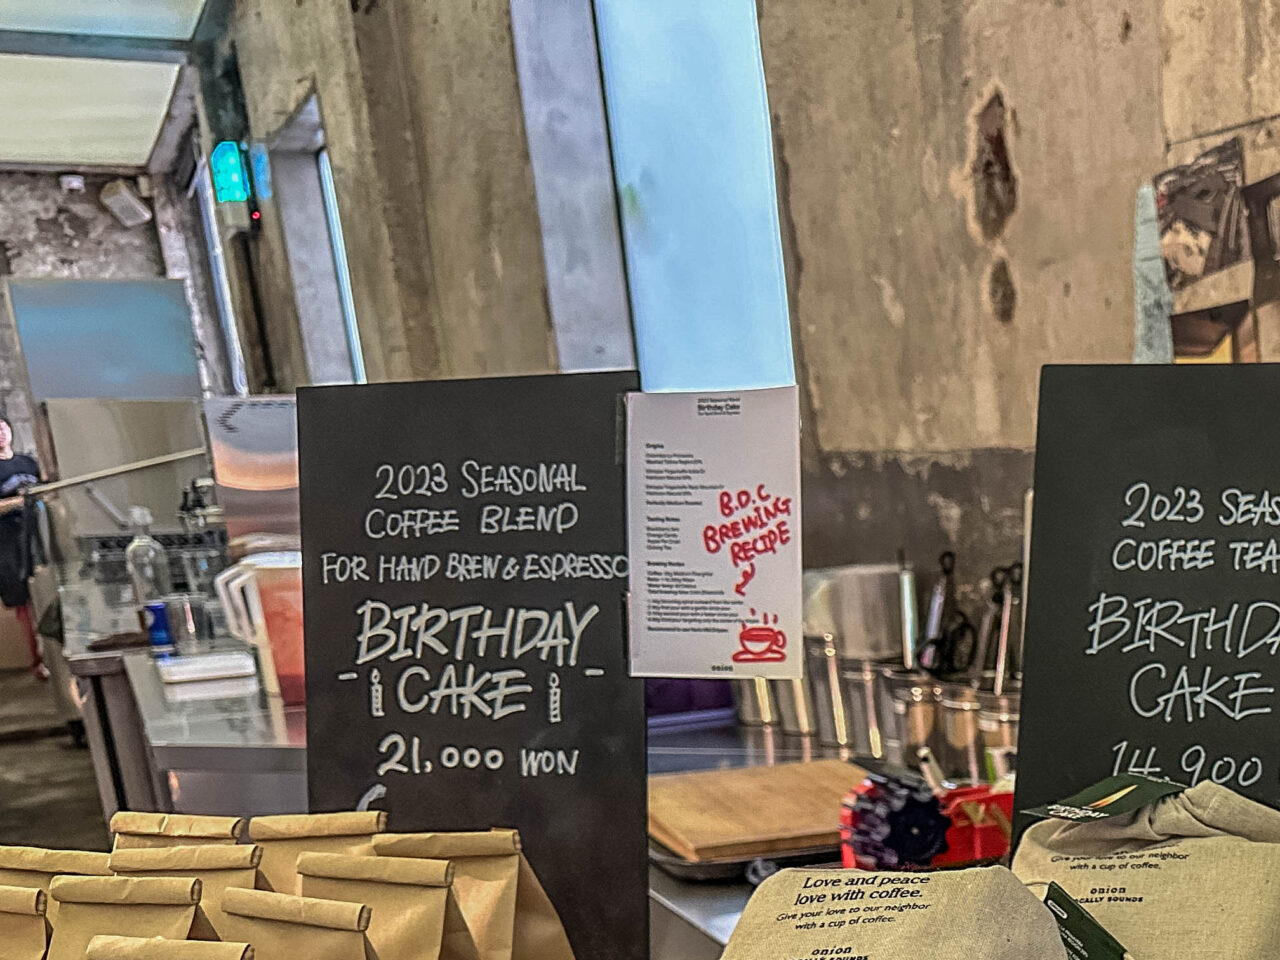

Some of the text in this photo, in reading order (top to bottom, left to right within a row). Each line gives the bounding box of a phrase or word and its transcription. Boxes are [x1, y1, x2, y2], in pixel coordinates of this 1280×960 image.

[376, 461, 587, 499] 2023 SEASONAL
[365, 504, 579, 539] COFFEE BLEND
[1121, 482, 1204, 529] 2023
[704, 497, 792, 554] BREWING
[730, 520, 791, 568] RECIPE
[1112, 537, 1216, 573] COFFEE
[321, 552, 629, 583] FOR HAND BREW & ESPRESSO
[355, 599, 600, 666] BIRTHDAY
[397, 665, 533, 721] CAKE
[1128, 667, 1276, 723] CAKE
[376, 733, 580, 777] 21,000 WON
[1148, 852, 1190, 861] neighbor
[794, 887, 924, 906] love with coffee.
[802, 875, 930, 889] Love and peace
[776, 902, 932, 922] Give your love our neighbor
[794, 920, 846, 930] with cup
[812, 946, 852, 956] onion
